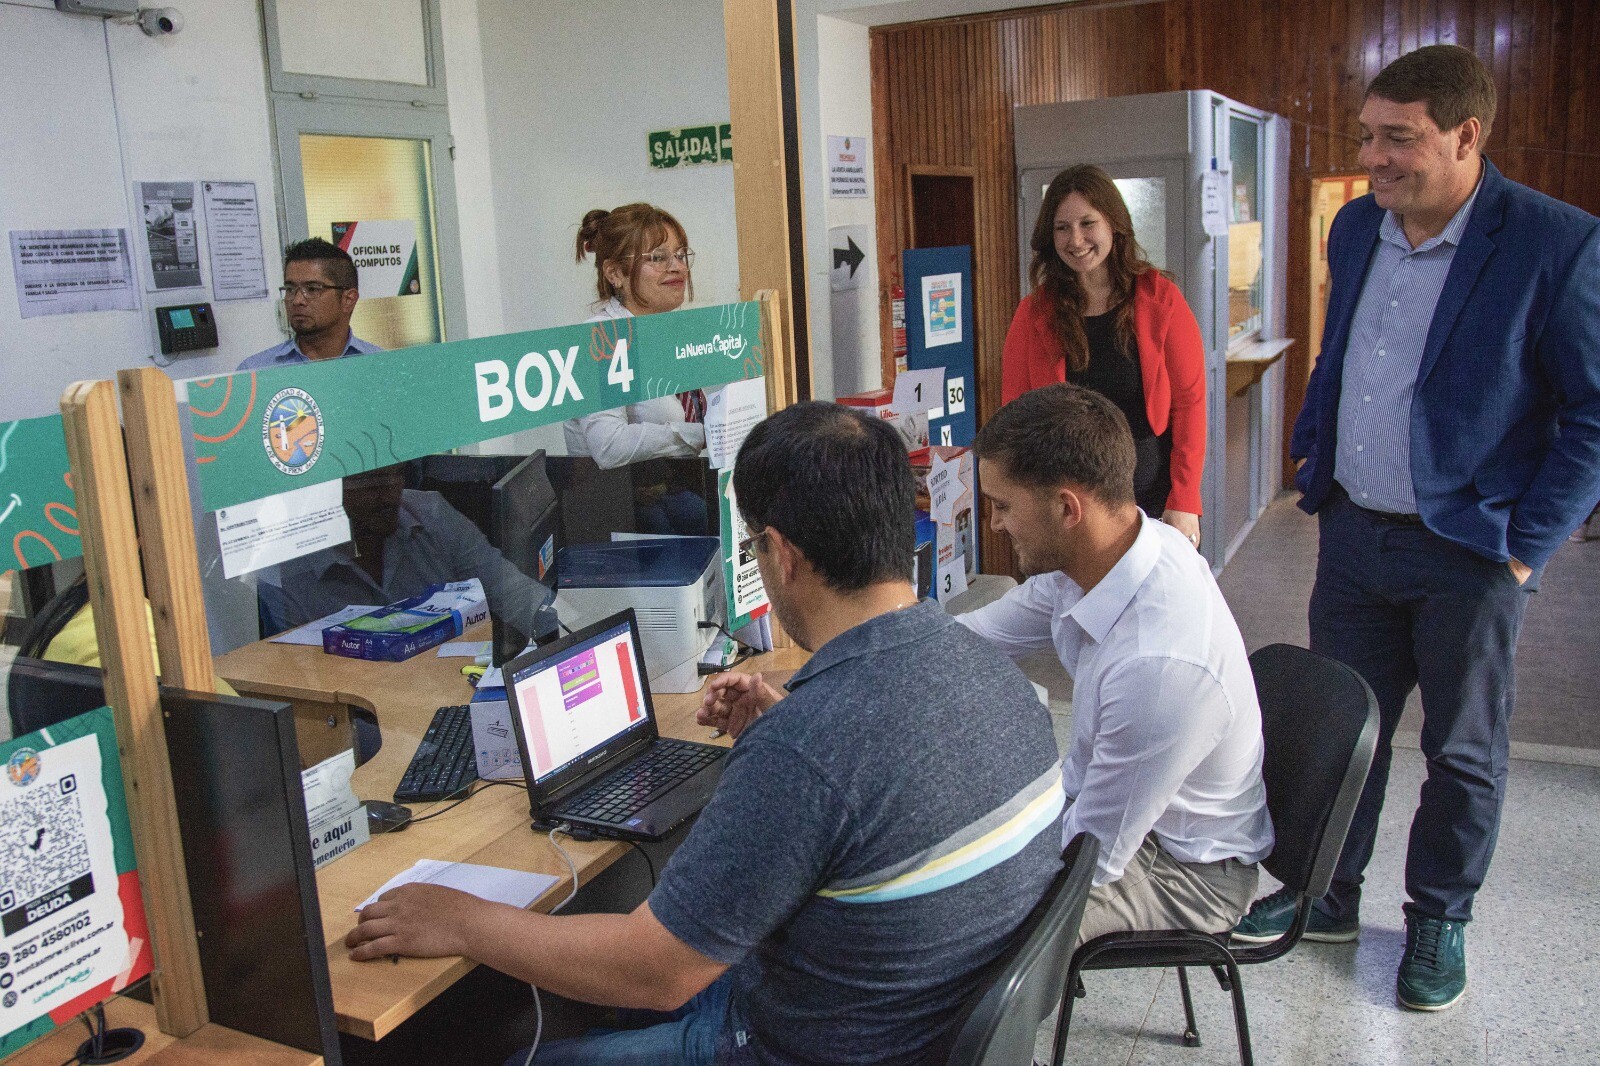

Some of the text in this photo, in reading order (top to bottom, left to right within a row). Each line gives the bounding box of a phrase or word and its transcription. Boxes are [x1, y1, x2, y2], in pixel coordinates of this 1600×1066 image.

[654, 136, 713, 160] SALIDA
[353, 245, 400, 255] OFICINA DE
[354, 257, 401, 267] COMPUTOS
[475, 338, 634, 423] BOX 4
[915, 383, 921, 402] 1
[949, 387, 963, 404] 30
[263, 389, 295, 439] MUNICIPALIDAD
[305, 395, 323, 426] RAWSON
[943, 431, 949, 446] Y
[945, 574, 951, 593] 3
[465, 611, 486, 627] Autor
[341, 640, 360, 649] Autor
[404, 642, 415, 654] A4
[312, 817, 352, 849] e aquí
[312, 838, 355, 866] ementerio
[27, 893, 72, 922] DEUDA
[42, 926, 57, 937] para
[59, 909, 89, 927] consultas
[14, 916, 91, 963] 280 4580102
